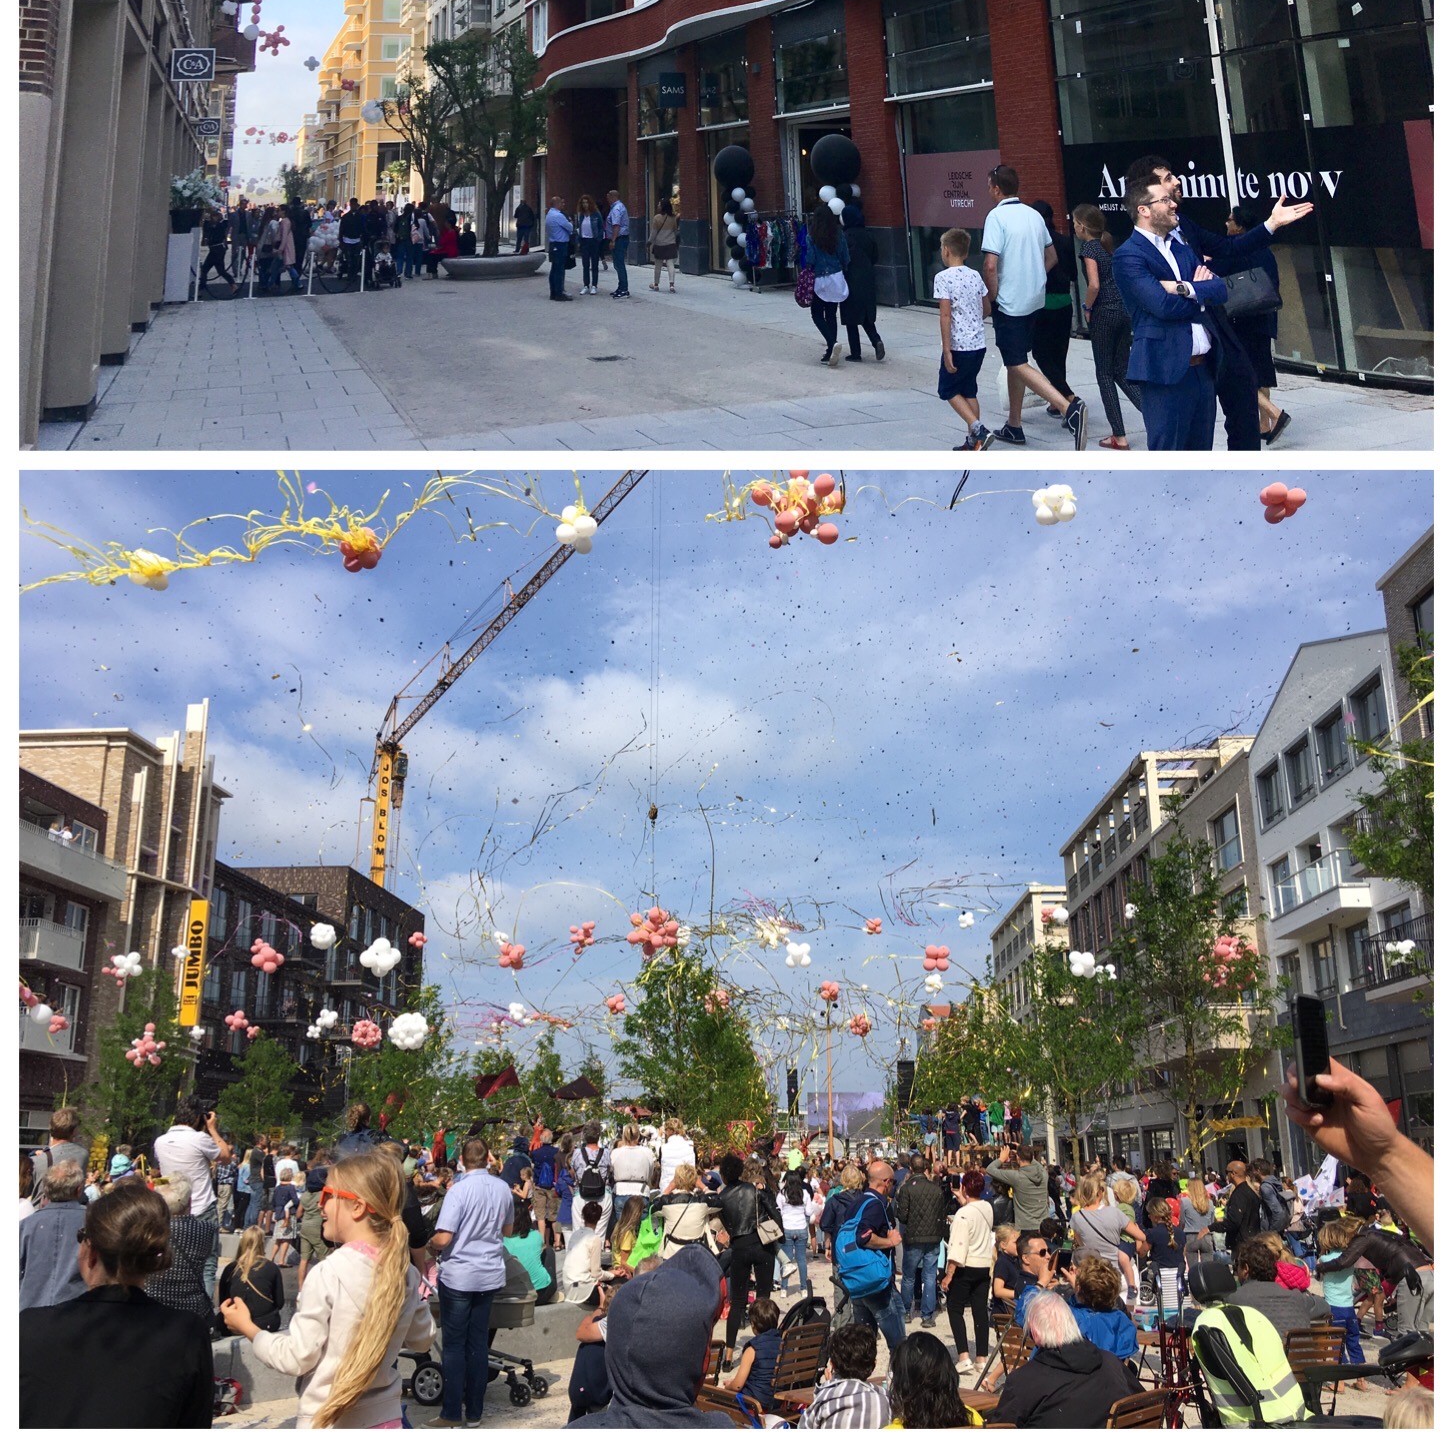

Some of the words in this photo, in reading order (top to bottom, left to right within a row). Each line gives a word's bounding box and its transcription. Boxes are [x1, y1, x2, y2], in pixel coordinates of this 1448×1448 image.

[183, 59, 204, 70] C&A
[661, 85, 685, 94] SAMS
[950, 199, 974, 207] UTRECHT
[381, 764, 389, 797] JOS
[375, 809, 387, 855] BLOM
[185, 920, 203, 990] JUMBO
